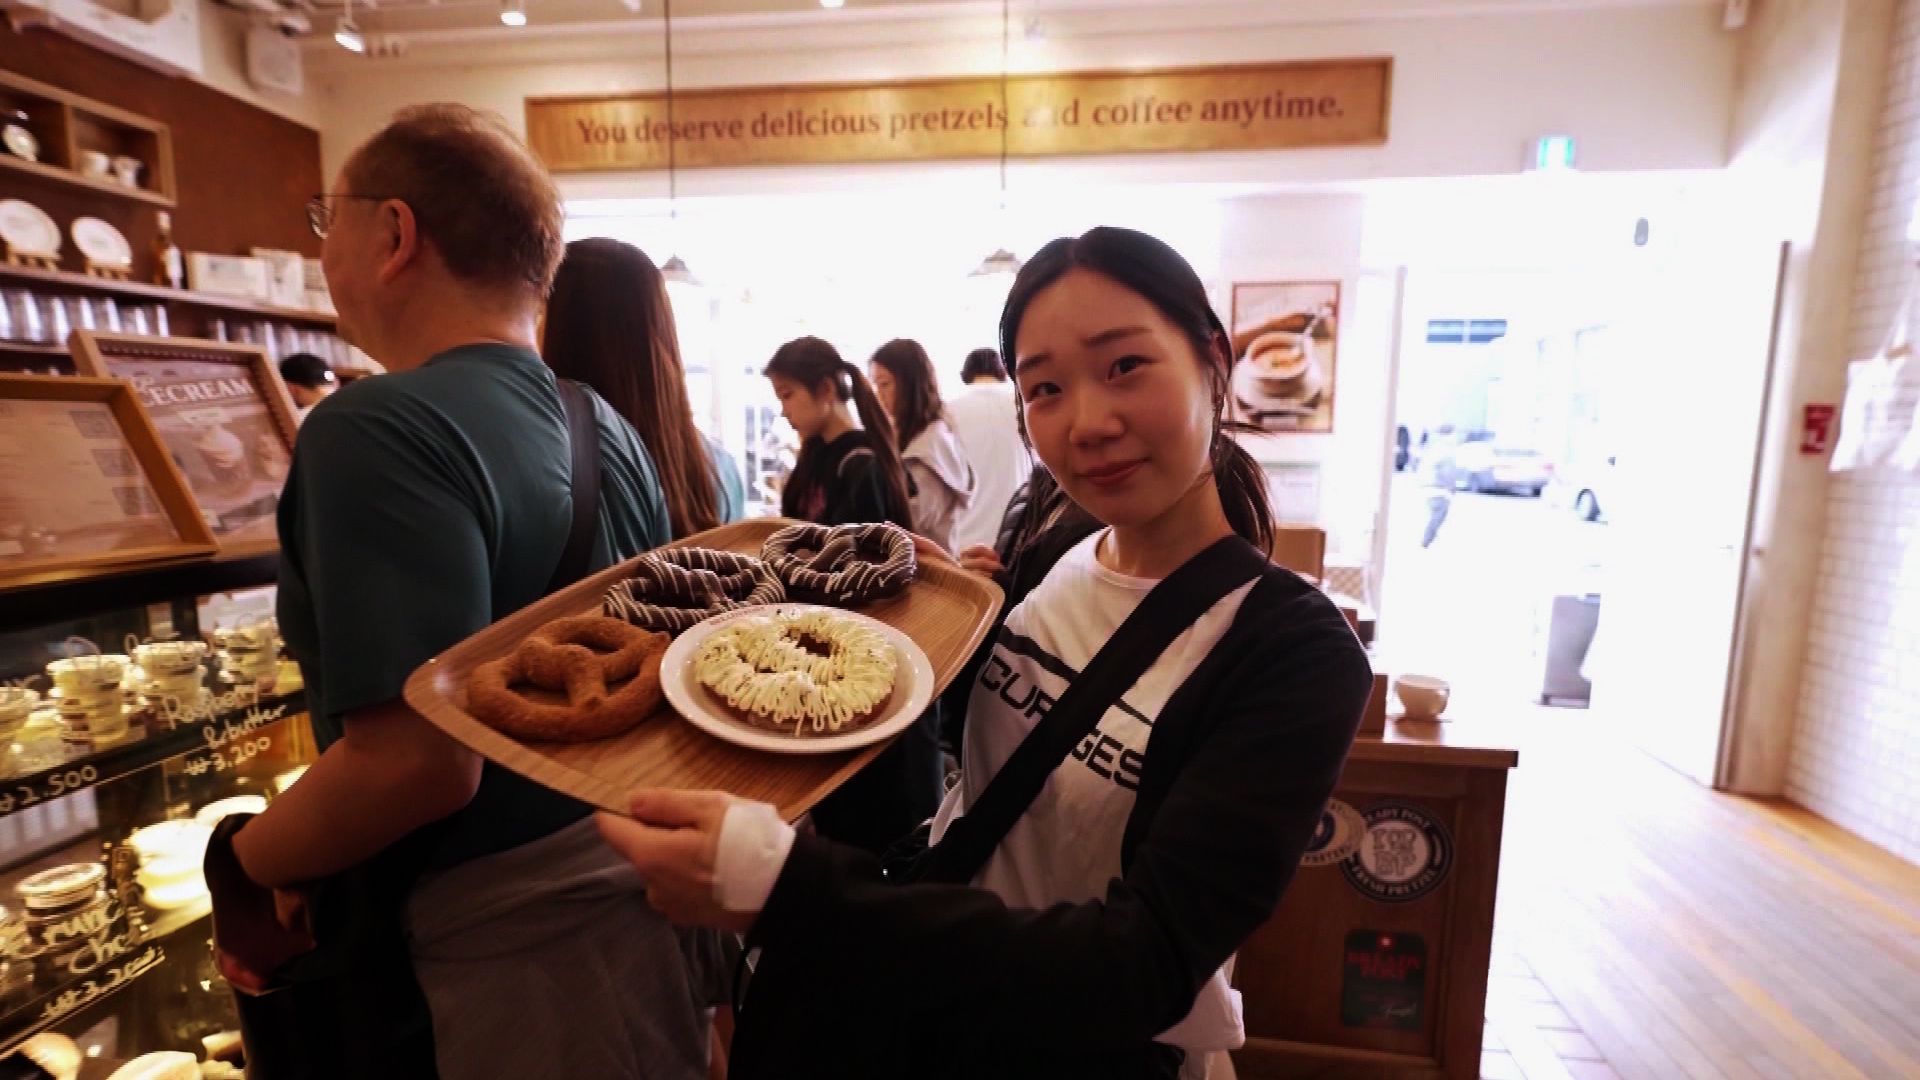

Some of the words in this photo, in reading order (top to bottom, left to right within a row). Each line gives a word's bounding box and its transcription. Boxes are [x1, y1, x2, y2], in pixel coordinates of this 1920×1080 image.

[577, 118, 628, 145] You
[635, 113, 744, 142] deserve
[751, 106, 881, 139] delicious
[889, 105, 1009, 139] pretzels
[1022, 98, 1081, 128] ad
[1092, 95, 1193, 126] coffee
[1201, 91, 1344, 128] anytime.
